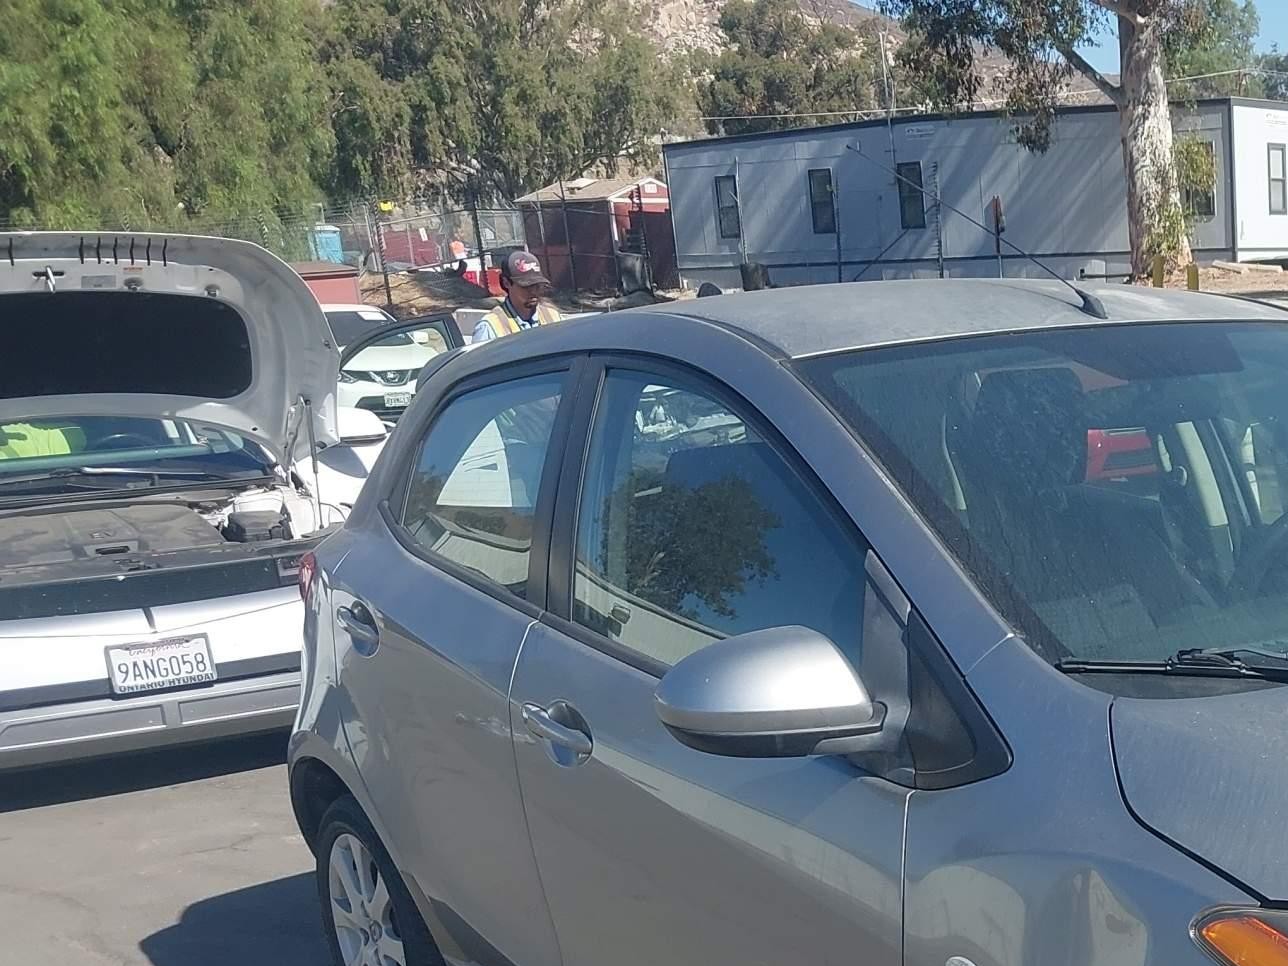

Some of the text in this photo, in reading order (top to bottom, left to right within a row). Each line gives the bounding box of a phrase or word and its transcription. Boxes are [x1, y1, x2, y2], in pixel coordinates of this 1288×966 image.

[117, 652, 207, 684] 9ANG058
[118, 672, 215, 693] ONTARIO HYUNDAI
